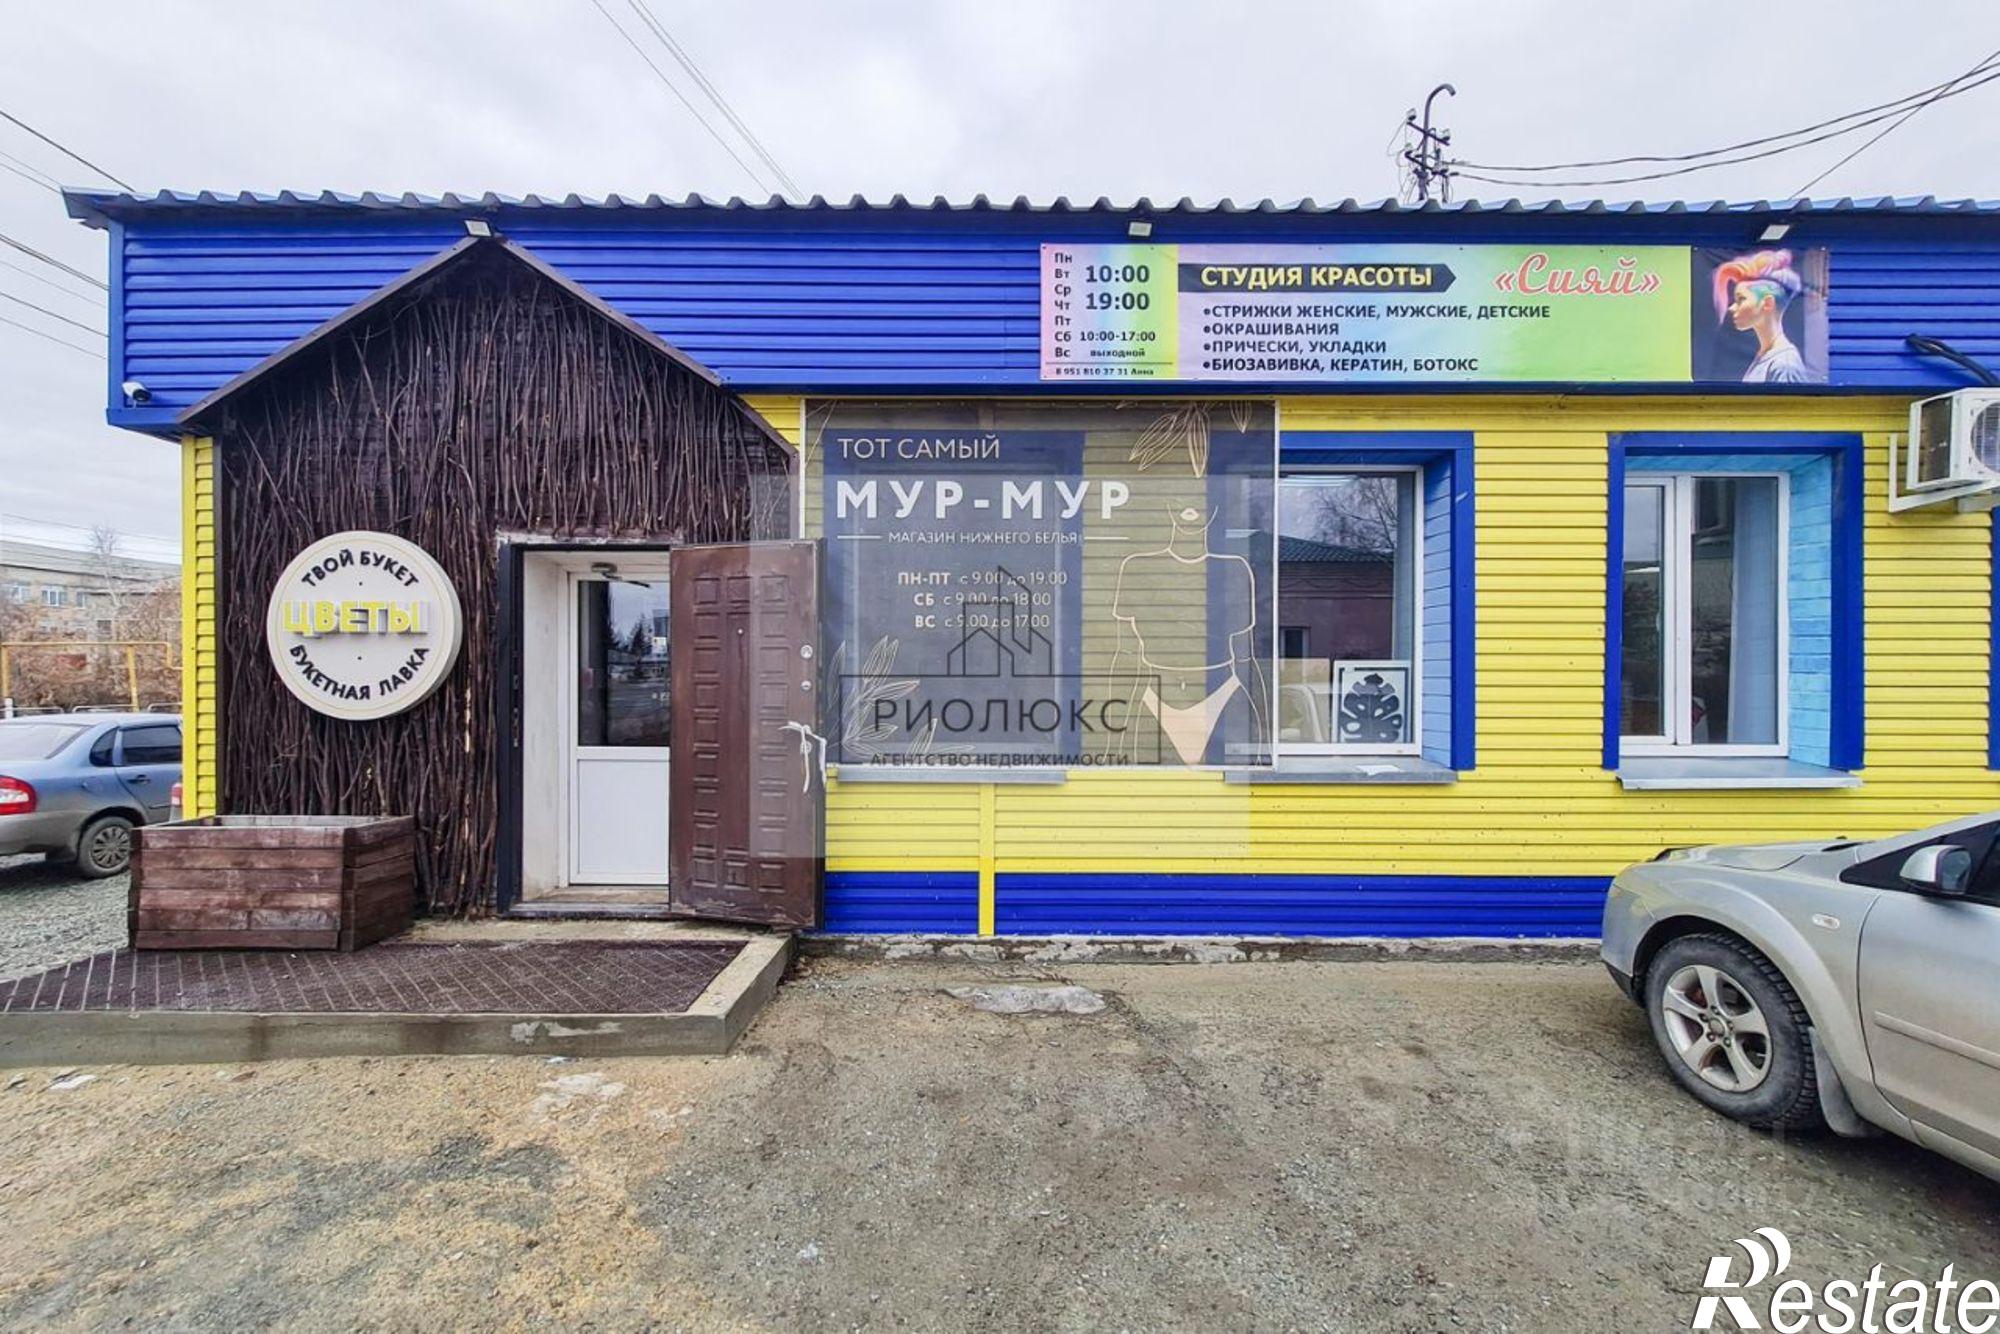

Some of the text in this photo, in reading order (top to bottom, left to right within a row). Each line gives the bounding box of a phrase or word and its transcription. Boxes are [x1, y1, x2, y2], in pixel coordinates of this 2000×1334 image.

[1054, 252, 1073, 263] Пн
[1054, 269, 1070, 278] Вт
[1085, 265, 1150, 283] 10:00
[1201, 267, 1432, 289] СТУДИЯ КРАСОТЫ
[1494, 252, 1662, 296] «Сияй»
[1054, 284, 1072, 297] Ср
[1054, 300, 1071, 310] Чт
[1085, 292, 1150, 310] 19:00
[1212, 305, 1550, 320] СТРИЖКИ ЖЕНСКИЕ, МУЖСКИЕ, ДЕТСКИЕ
[1054, 315, 1071, 325] Пт
[1212, 323, 1339, 335] ОКРАШИВАНИЯ
[1054, 331, 1156, 342] Сб 10:00-17:00
[1054, 347, 1146, 358] Вс выходной
[1212, 341, 1386, 355] ПРИЧЕСКИ, УКЛАДКИ
[1212, 358, 1479, 373] БИОЗАВИВКА, КЕРАТИН, БОТОКС
[837, 434, 1000, 459] ТОТ САМЫЙ
[836, 480, 1130, 520] МУР-МУР
[888, 532, 1078, 545] МАГАЗИН НИЖНЕГО БЕЛЬЯ
[301, 548, 420, 587] ТВОЙ БУКЕТ
[898, 572, 951, 585] ПН-ПТ
[960, 575, 968, 585] с
[971, 571, 1003, 585] 9.00
[1029, 571, 1068, 585] 19.00
[913, 593, 935, 606] СБ
[283, 600, 424, 639] ЦВЕТЫ
[914, 615, 936, 628] ВС
[289, 644, 430, 700] БУКЕТНАЯ ЛАВКА
